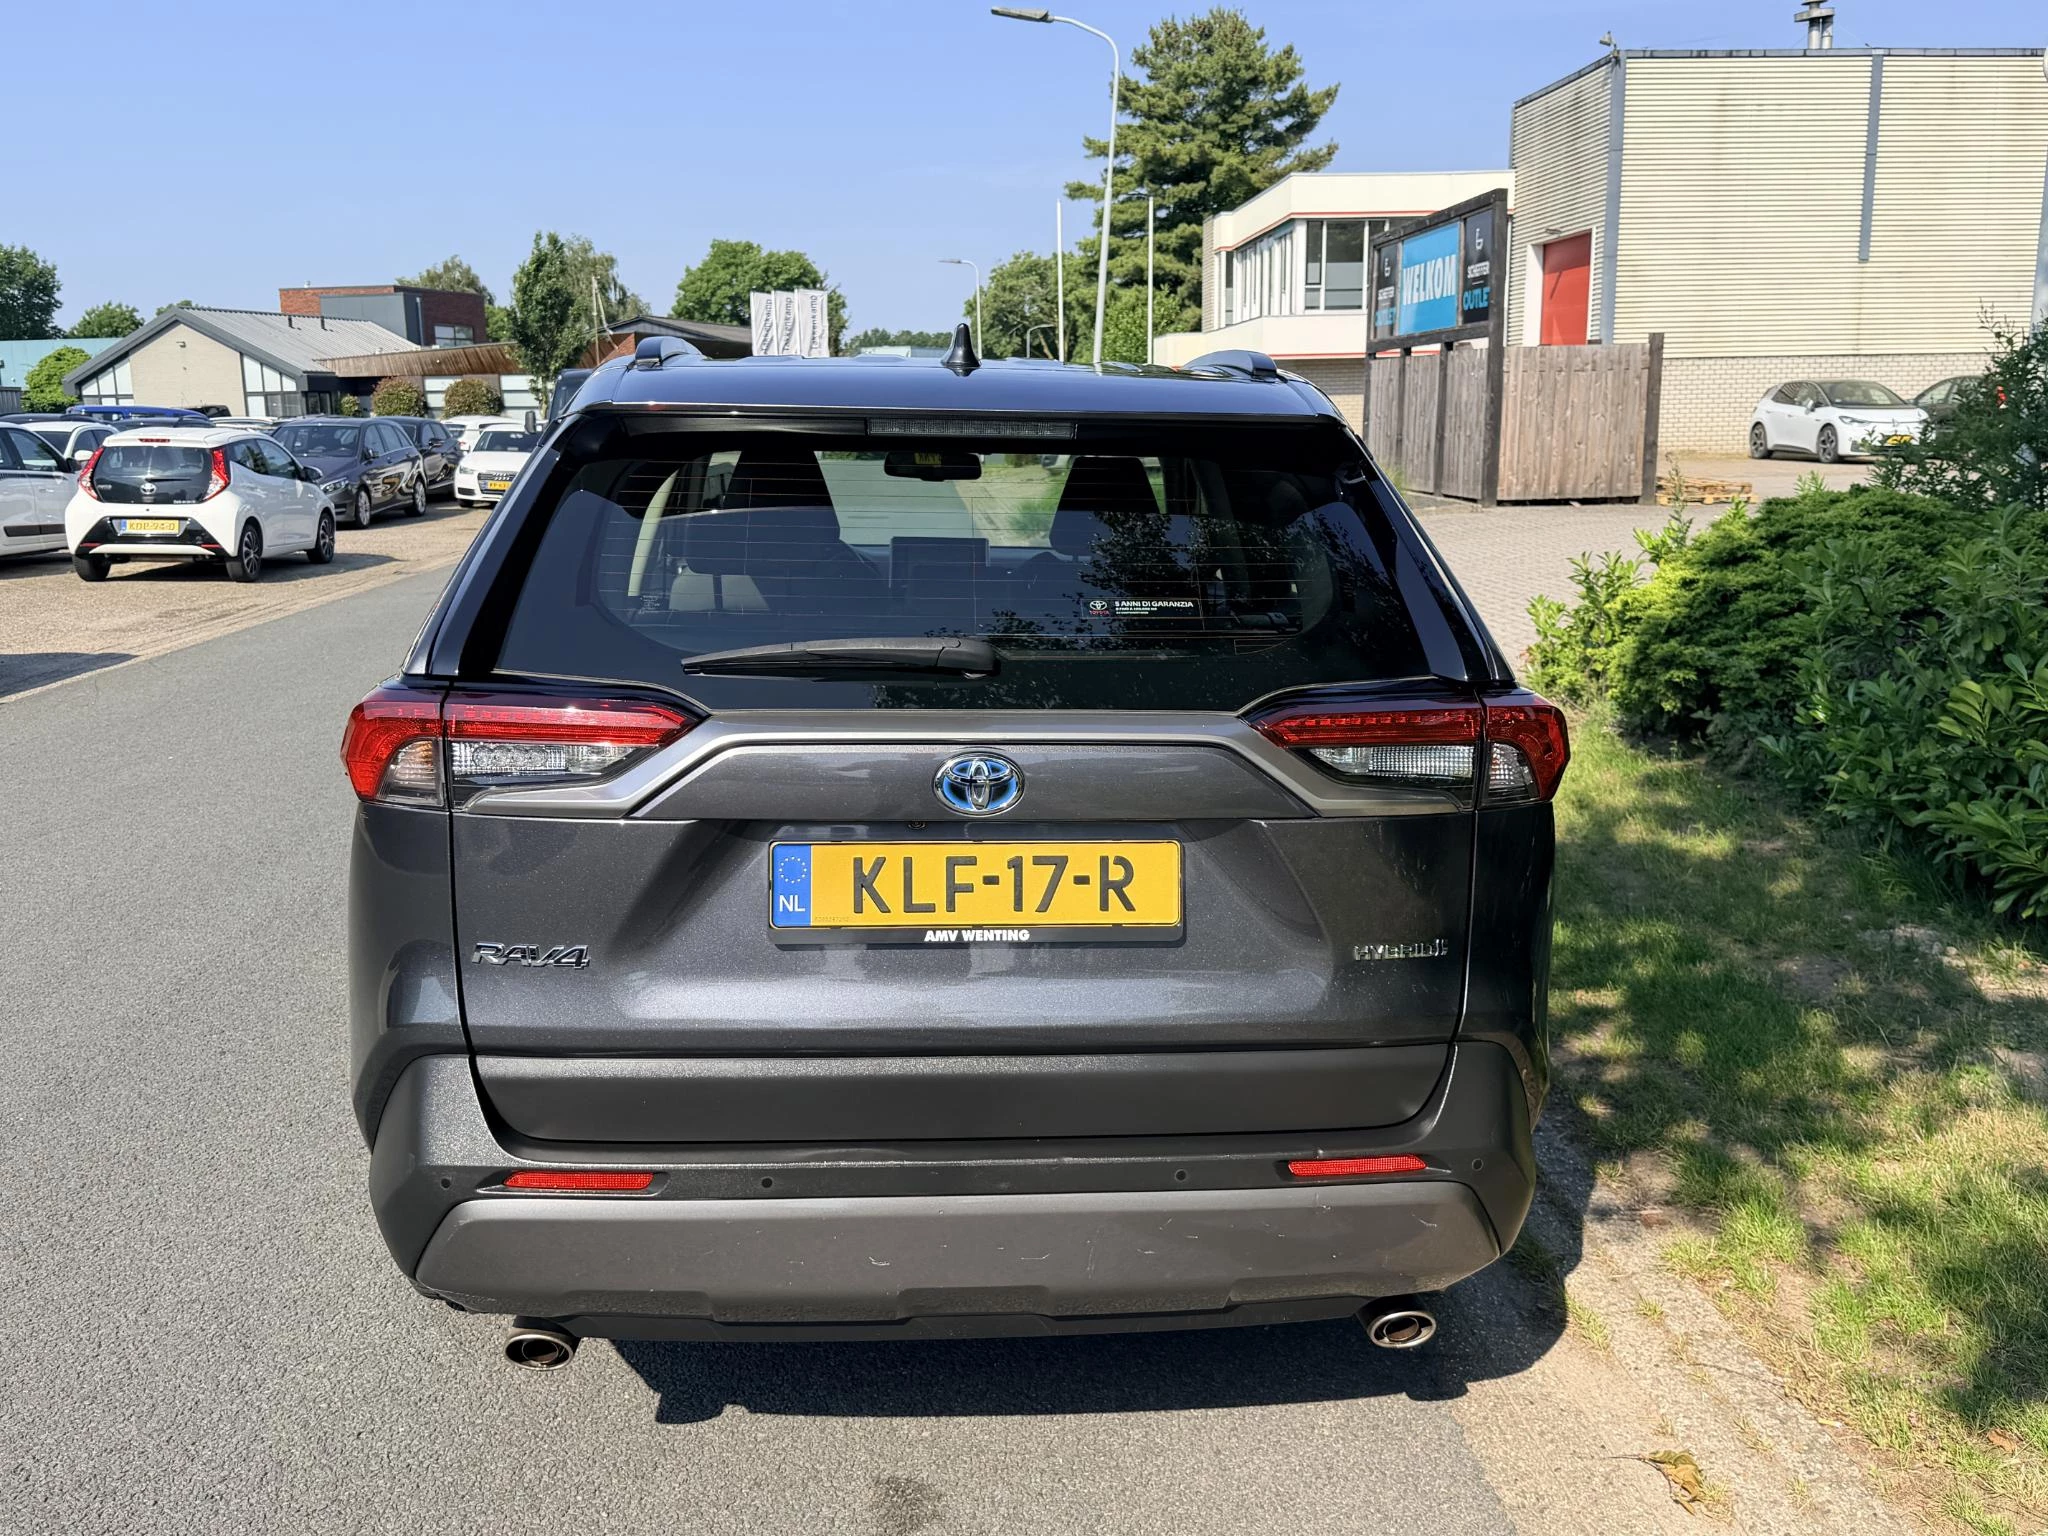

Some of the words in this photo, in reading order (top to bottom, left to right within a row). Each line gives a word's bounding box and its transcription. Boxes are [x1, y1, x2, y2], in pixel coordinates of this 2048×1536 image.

[402, 254, 457, 306] WELKOM
[852, 855, 1137, 914] KLF-17-R
[778, 895, 806, 913] NL
[924, 929, 958, 942] AMV
[961, 929, 1031, 943] WENTING
[471, 942, 591, 970] RAV4
